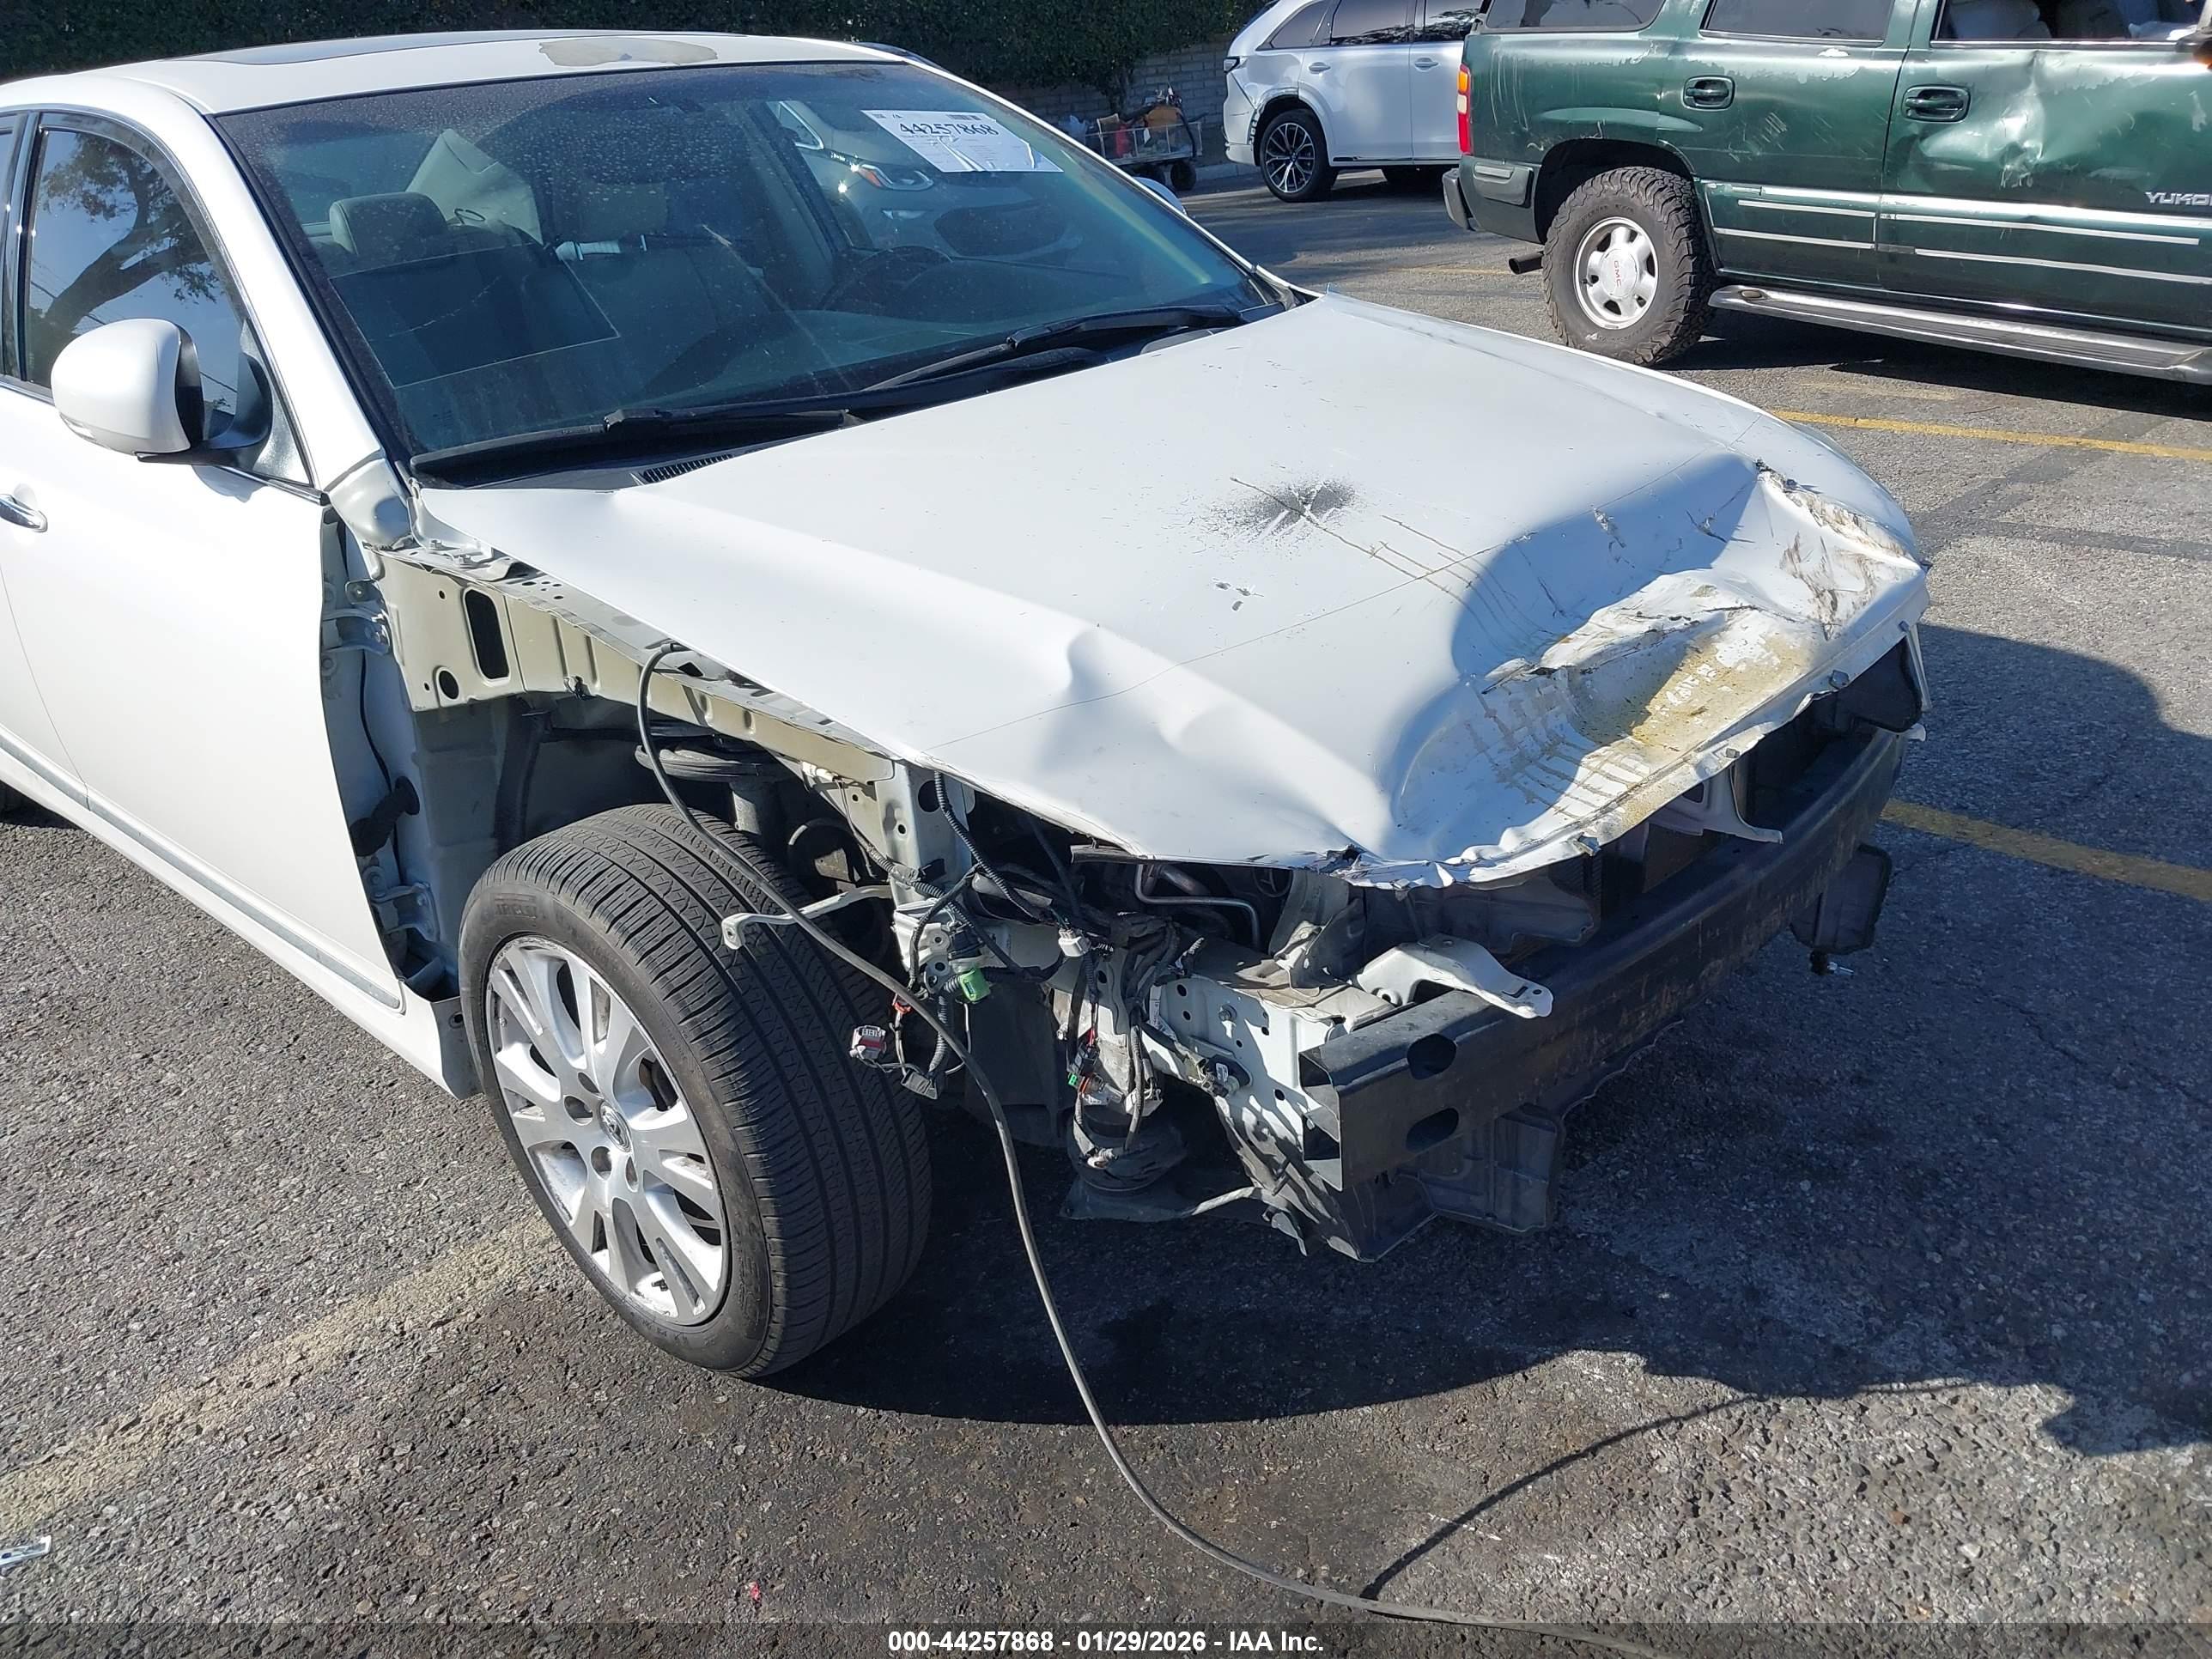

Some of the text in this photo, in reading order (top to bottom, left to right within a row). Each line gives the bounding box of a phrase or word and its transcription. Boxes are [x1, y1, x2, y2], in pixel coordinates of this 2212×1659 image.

[899, 122, 1000, 136] 44257868
[2144, 191, 2212, 207] YUKO
[1613, 260, 1622, 288] GMC
